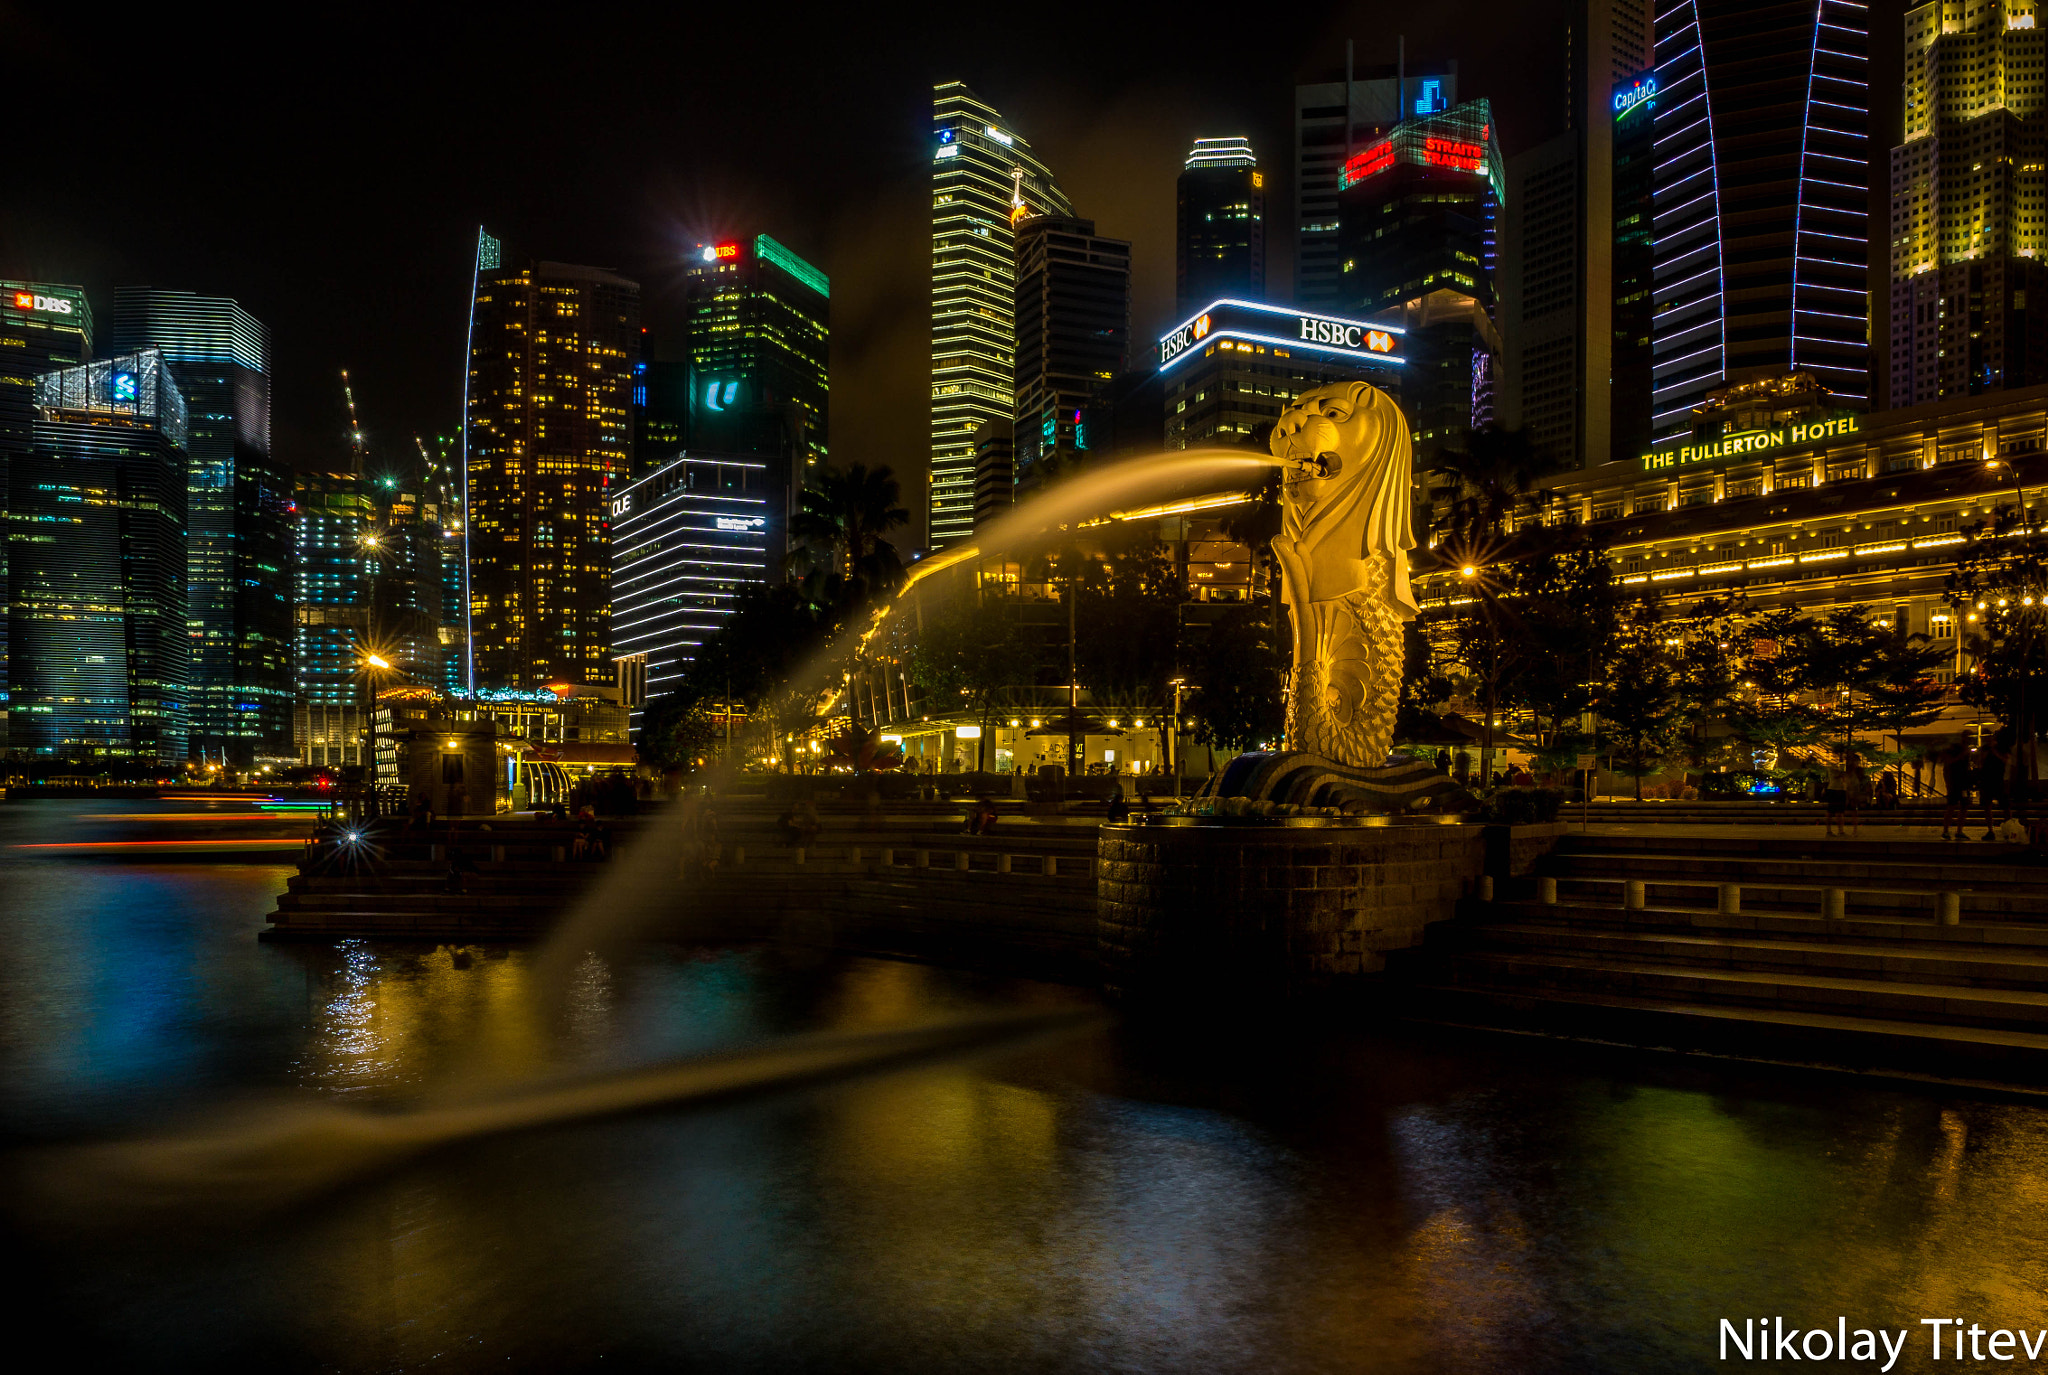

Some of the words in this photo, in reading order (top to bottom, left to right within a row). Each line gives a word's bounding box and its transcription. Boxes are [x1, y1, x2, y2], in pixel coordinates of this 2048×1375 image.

[1425, 137, 1481, 158] STRAITS
[1422, 150, 1481, 170] TRADING
[715, 245, 736, 258] UBS
[33, 295, 72, 314] DBS
[1299, 317, 1361, 348] HSBC
[1160, 324, 1194, 364] HSBC
[1641, 451, 1675, 471] THE
[1680, 430, 1784, 464] FULLERTON
[1791, 416, 1859, 443] HOTEL
[612, 494, 631, 517] OUE
